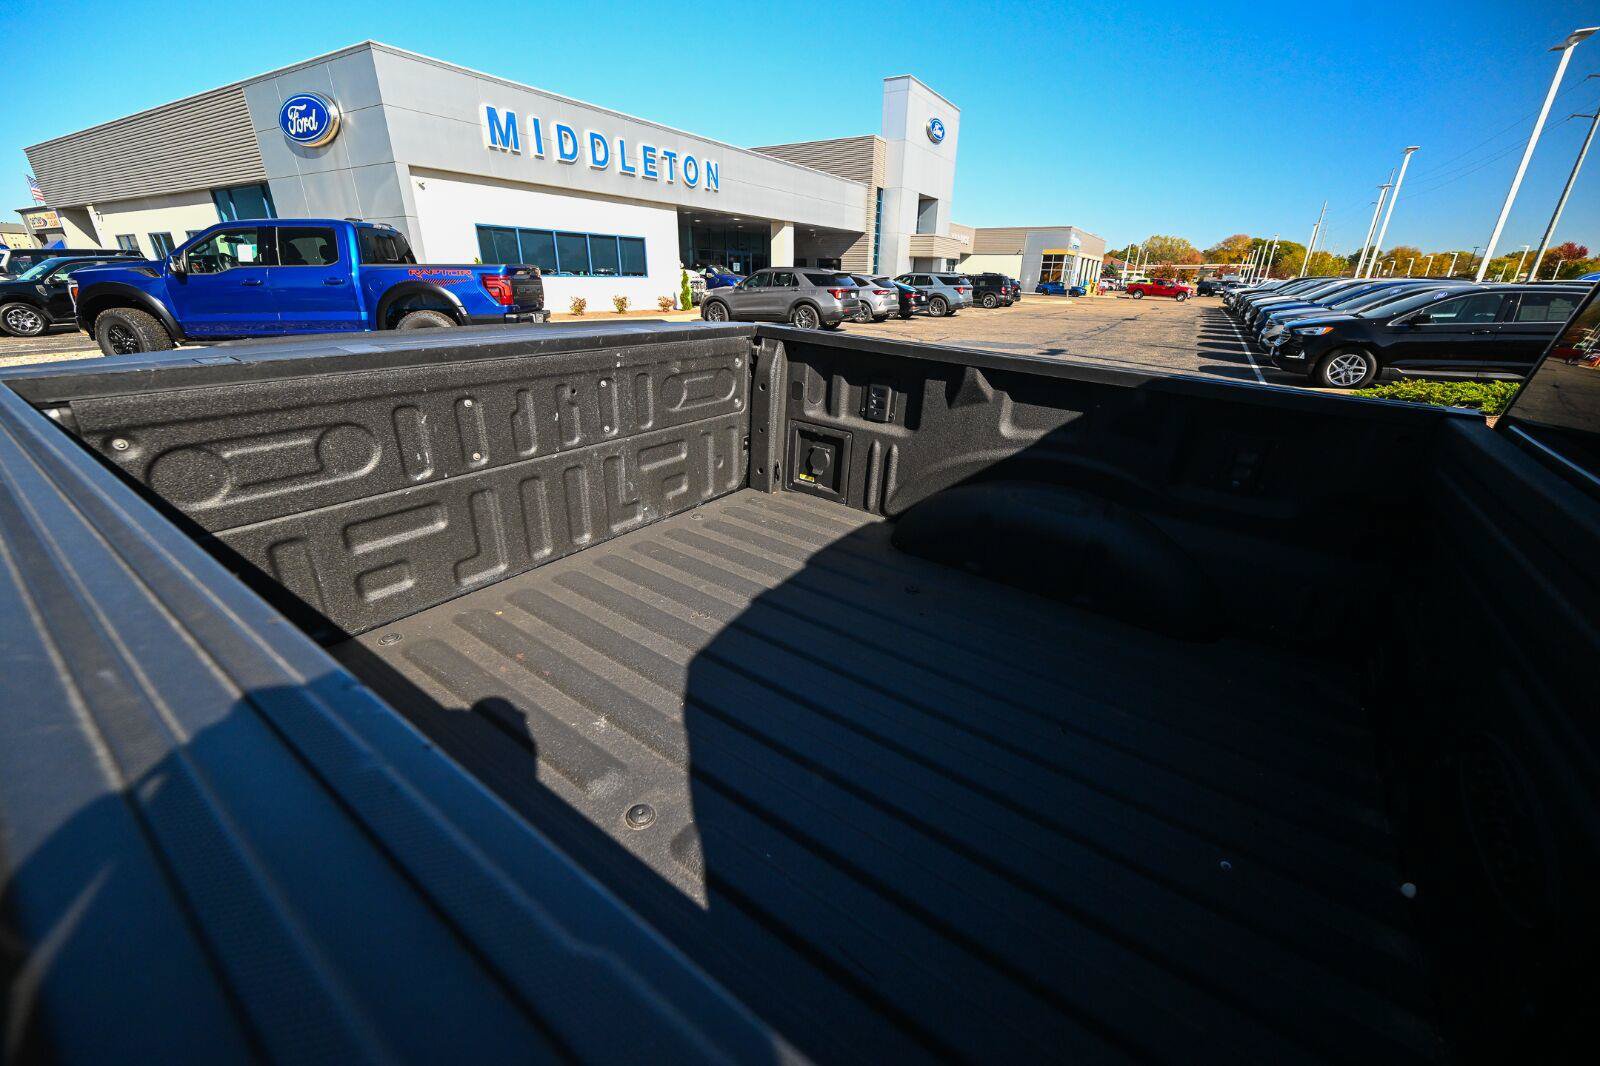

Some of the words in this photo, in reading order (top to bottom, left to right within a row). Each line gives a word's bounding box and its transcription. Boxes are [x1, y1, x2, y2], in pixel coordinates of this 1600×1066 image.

[287, 103, 319, 135] Ford
[482, 104, 721, 193] MIDDLETON
[408, 269, 473, 278] RAPTOR
